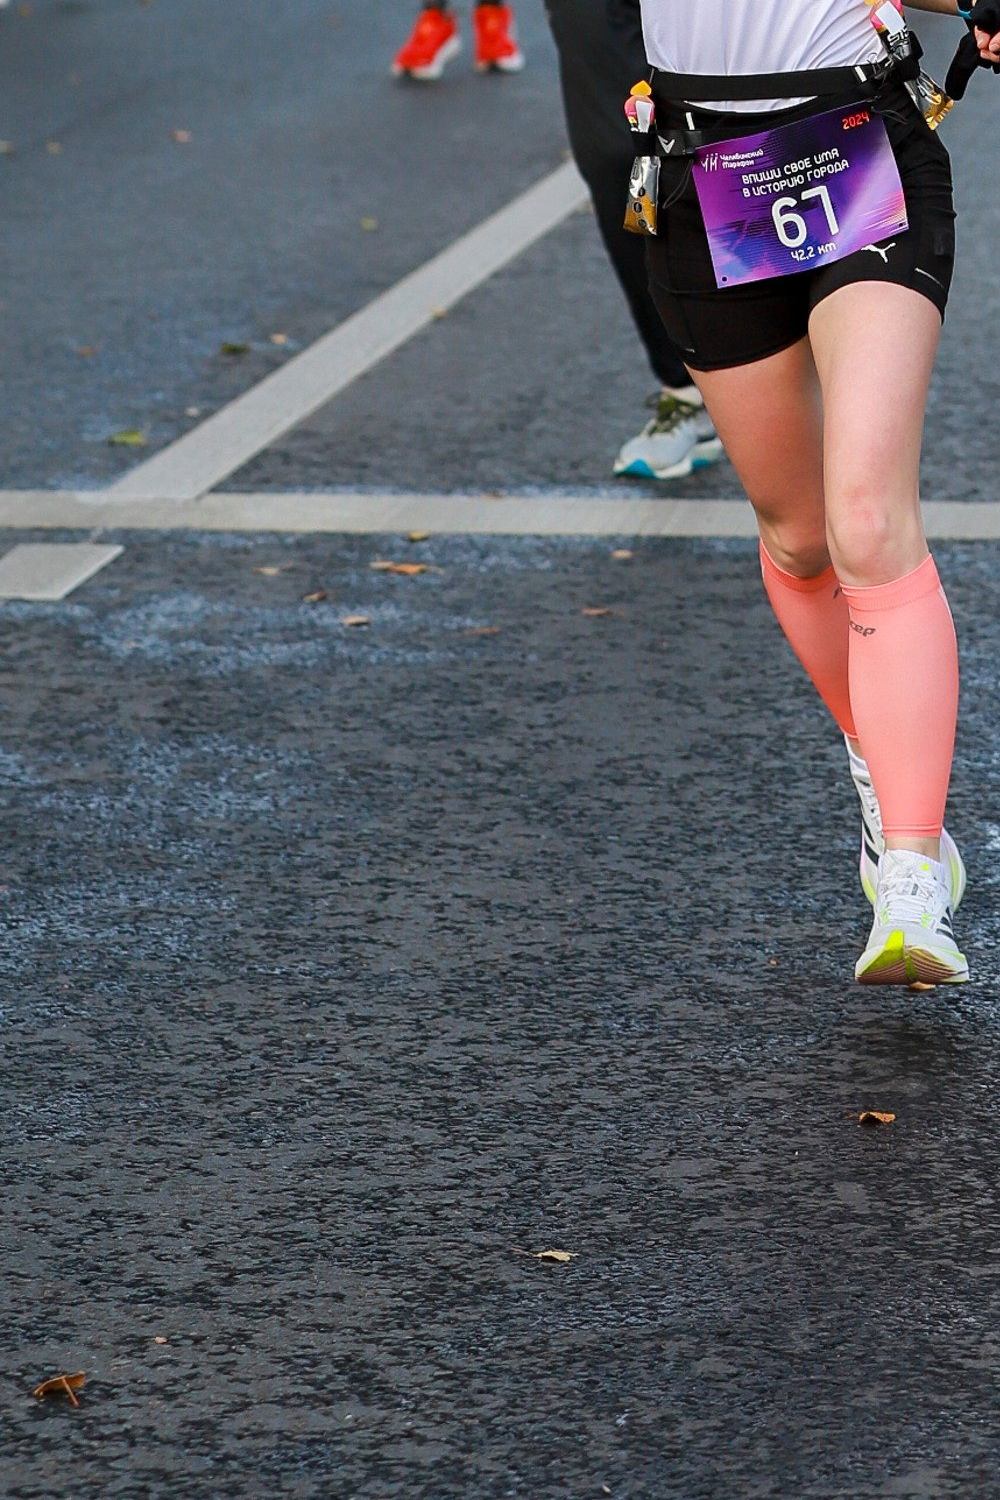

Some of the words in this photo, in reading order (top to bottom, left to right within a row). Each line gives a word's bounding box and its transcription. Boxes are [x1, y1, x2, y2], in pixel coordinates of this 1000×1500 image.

[842, 111, 870, 130] 2024
[720, 148, 764, 161] Челябинский
[722, 159, 755, 169] Марафон
[741, 167, 782, 185] ВПИШИ
[784, 157, 812, 175] СВОЕ
[814, 147, 840, 165] ИМЯ
[742, 187, 751, 198] В
[752, 174, 805, 196] ИСТОРИЮ
[807, 159, 850, 182] ГОРОДА
[771, 185, 840, 248] 67
